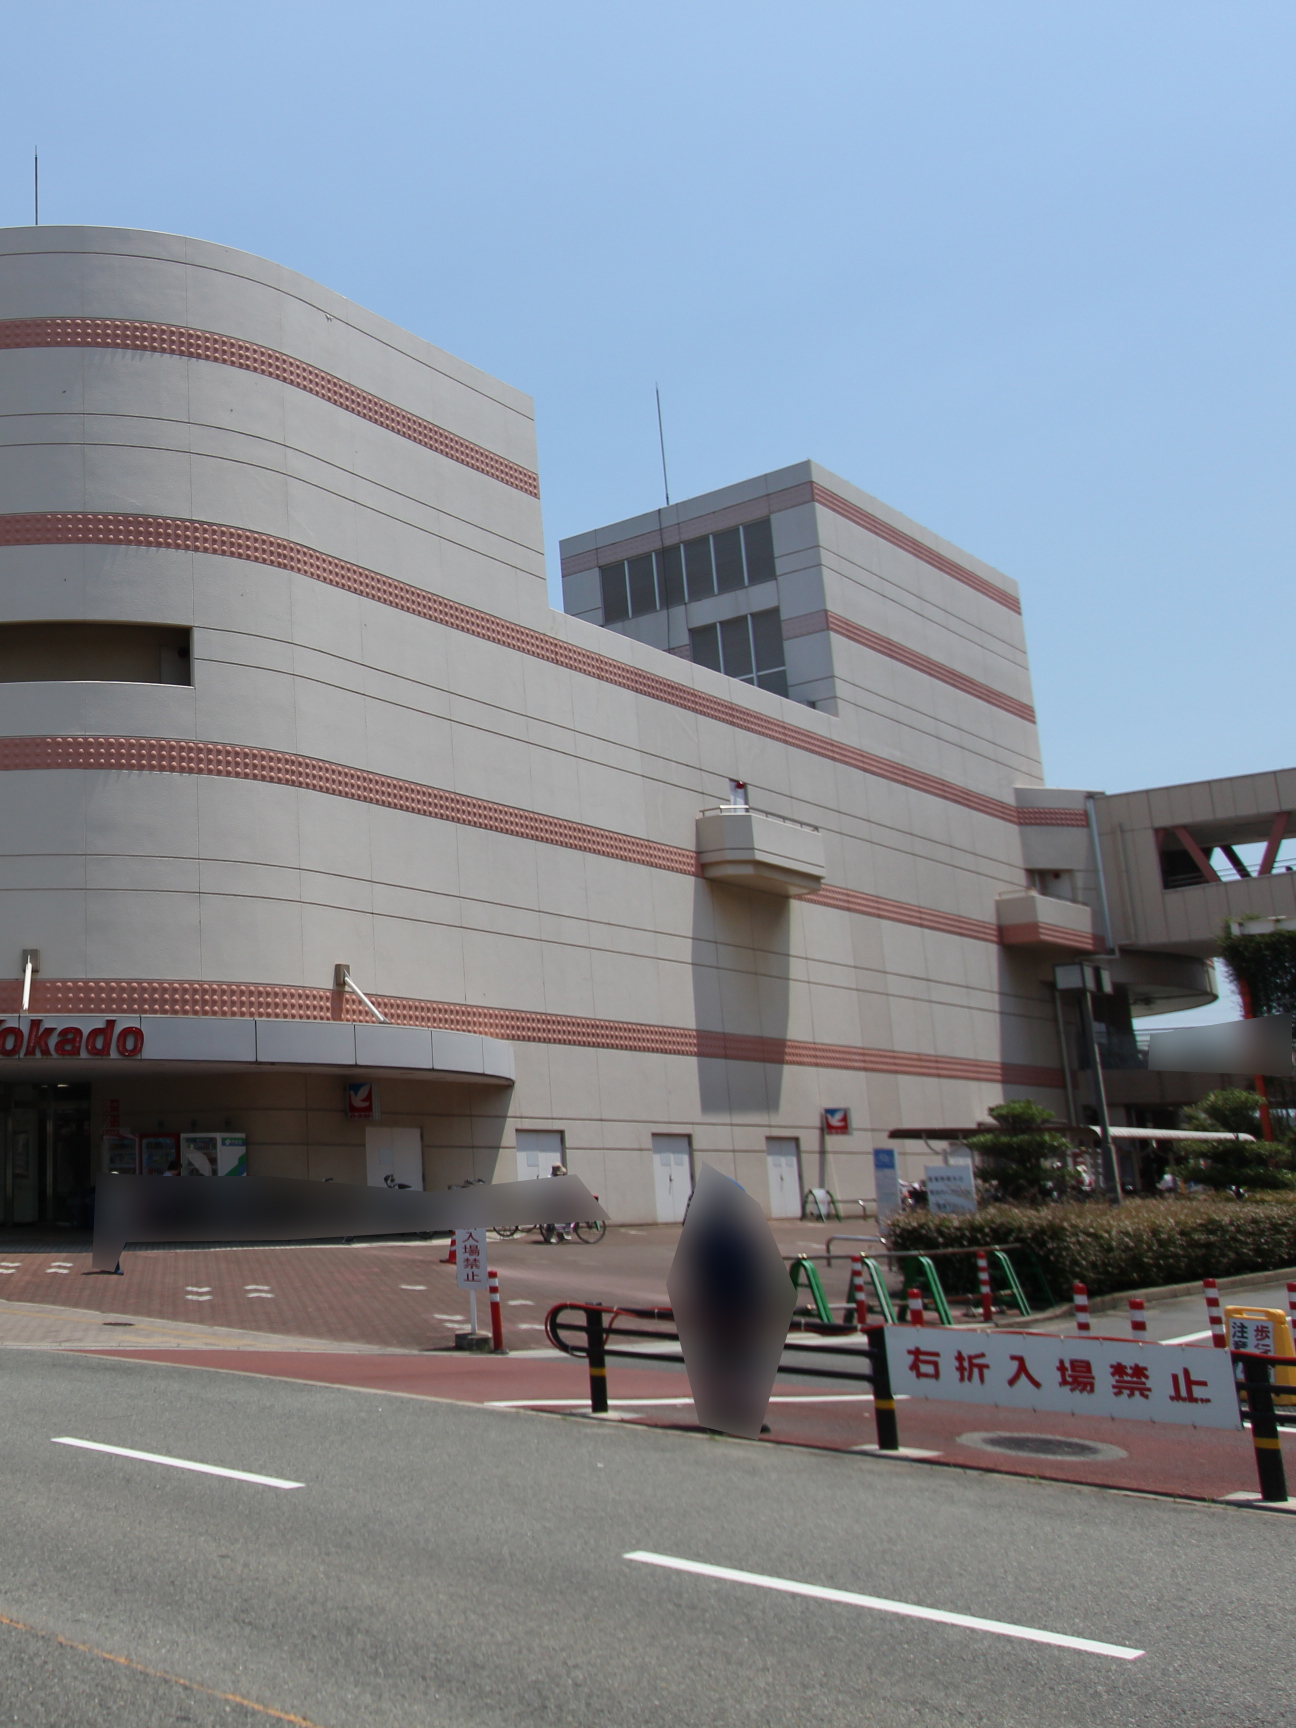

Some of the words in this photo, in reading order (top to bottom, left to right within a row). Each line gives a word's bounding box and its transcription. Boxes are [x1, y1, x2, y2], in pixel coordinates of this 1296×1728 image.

[462, 1228, 482, 1283] 入場禁止
[1253, 1324, 1272, 1356] 歩行
[906, 1346, 1212, 1405] 右折入場禁止
